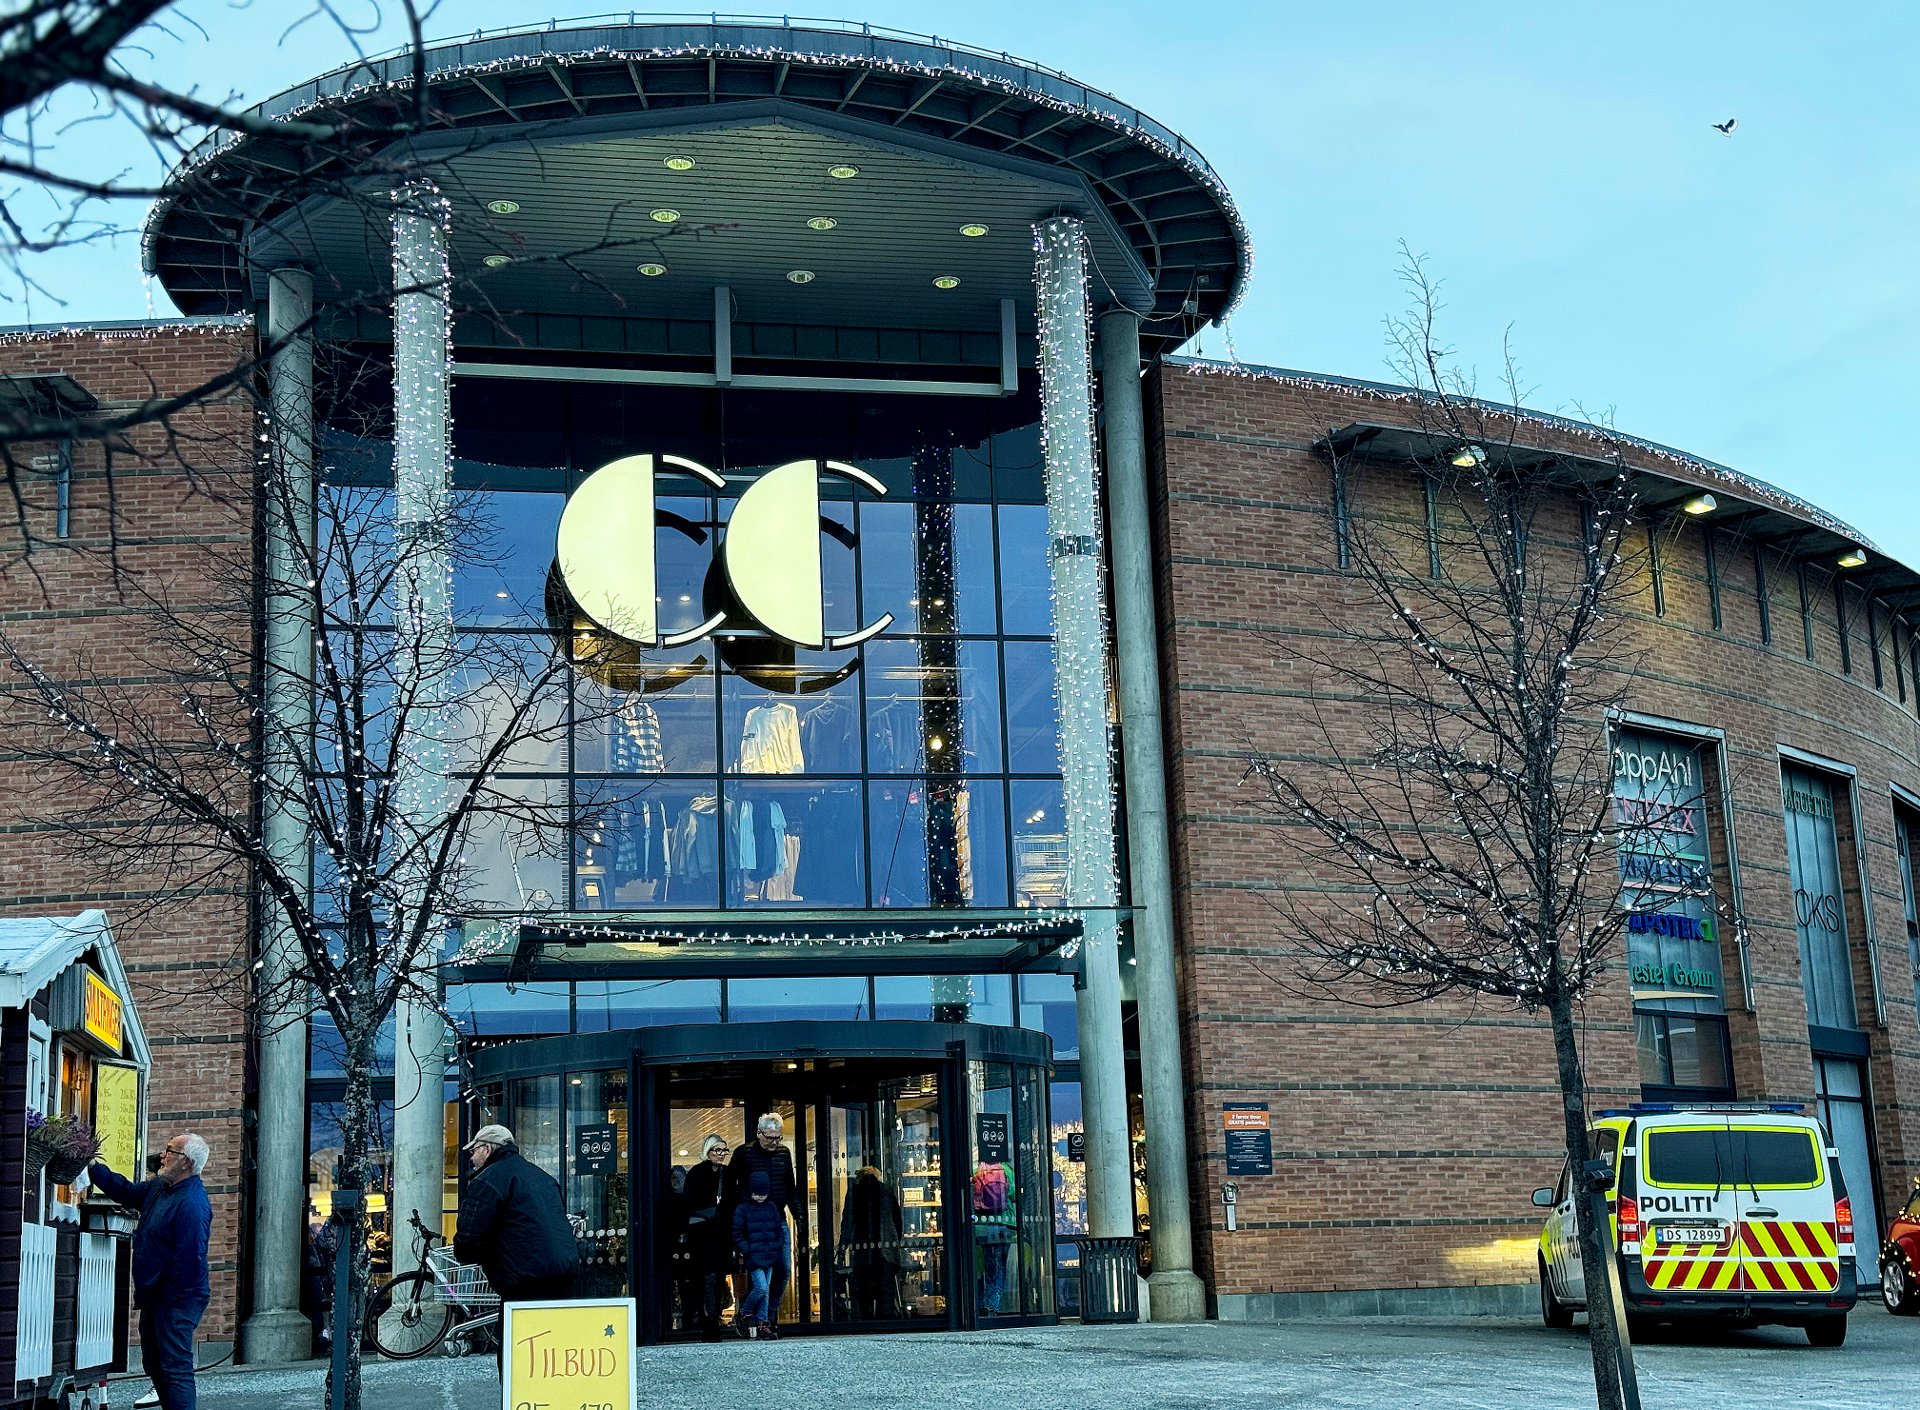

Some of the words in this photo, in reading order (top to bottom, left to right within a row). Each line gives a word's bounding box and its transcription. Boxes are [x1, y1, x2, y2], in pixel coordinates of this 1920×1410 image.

[1631, 963, 1666, 985] ester
[1640, 1196, 1712, 1213] POLITI
[1666, 1230, 1681, 1240] DS
[1686, 1230, 1721, 1240] 12899
[517, 1330, 617, 1378] TILBUD
